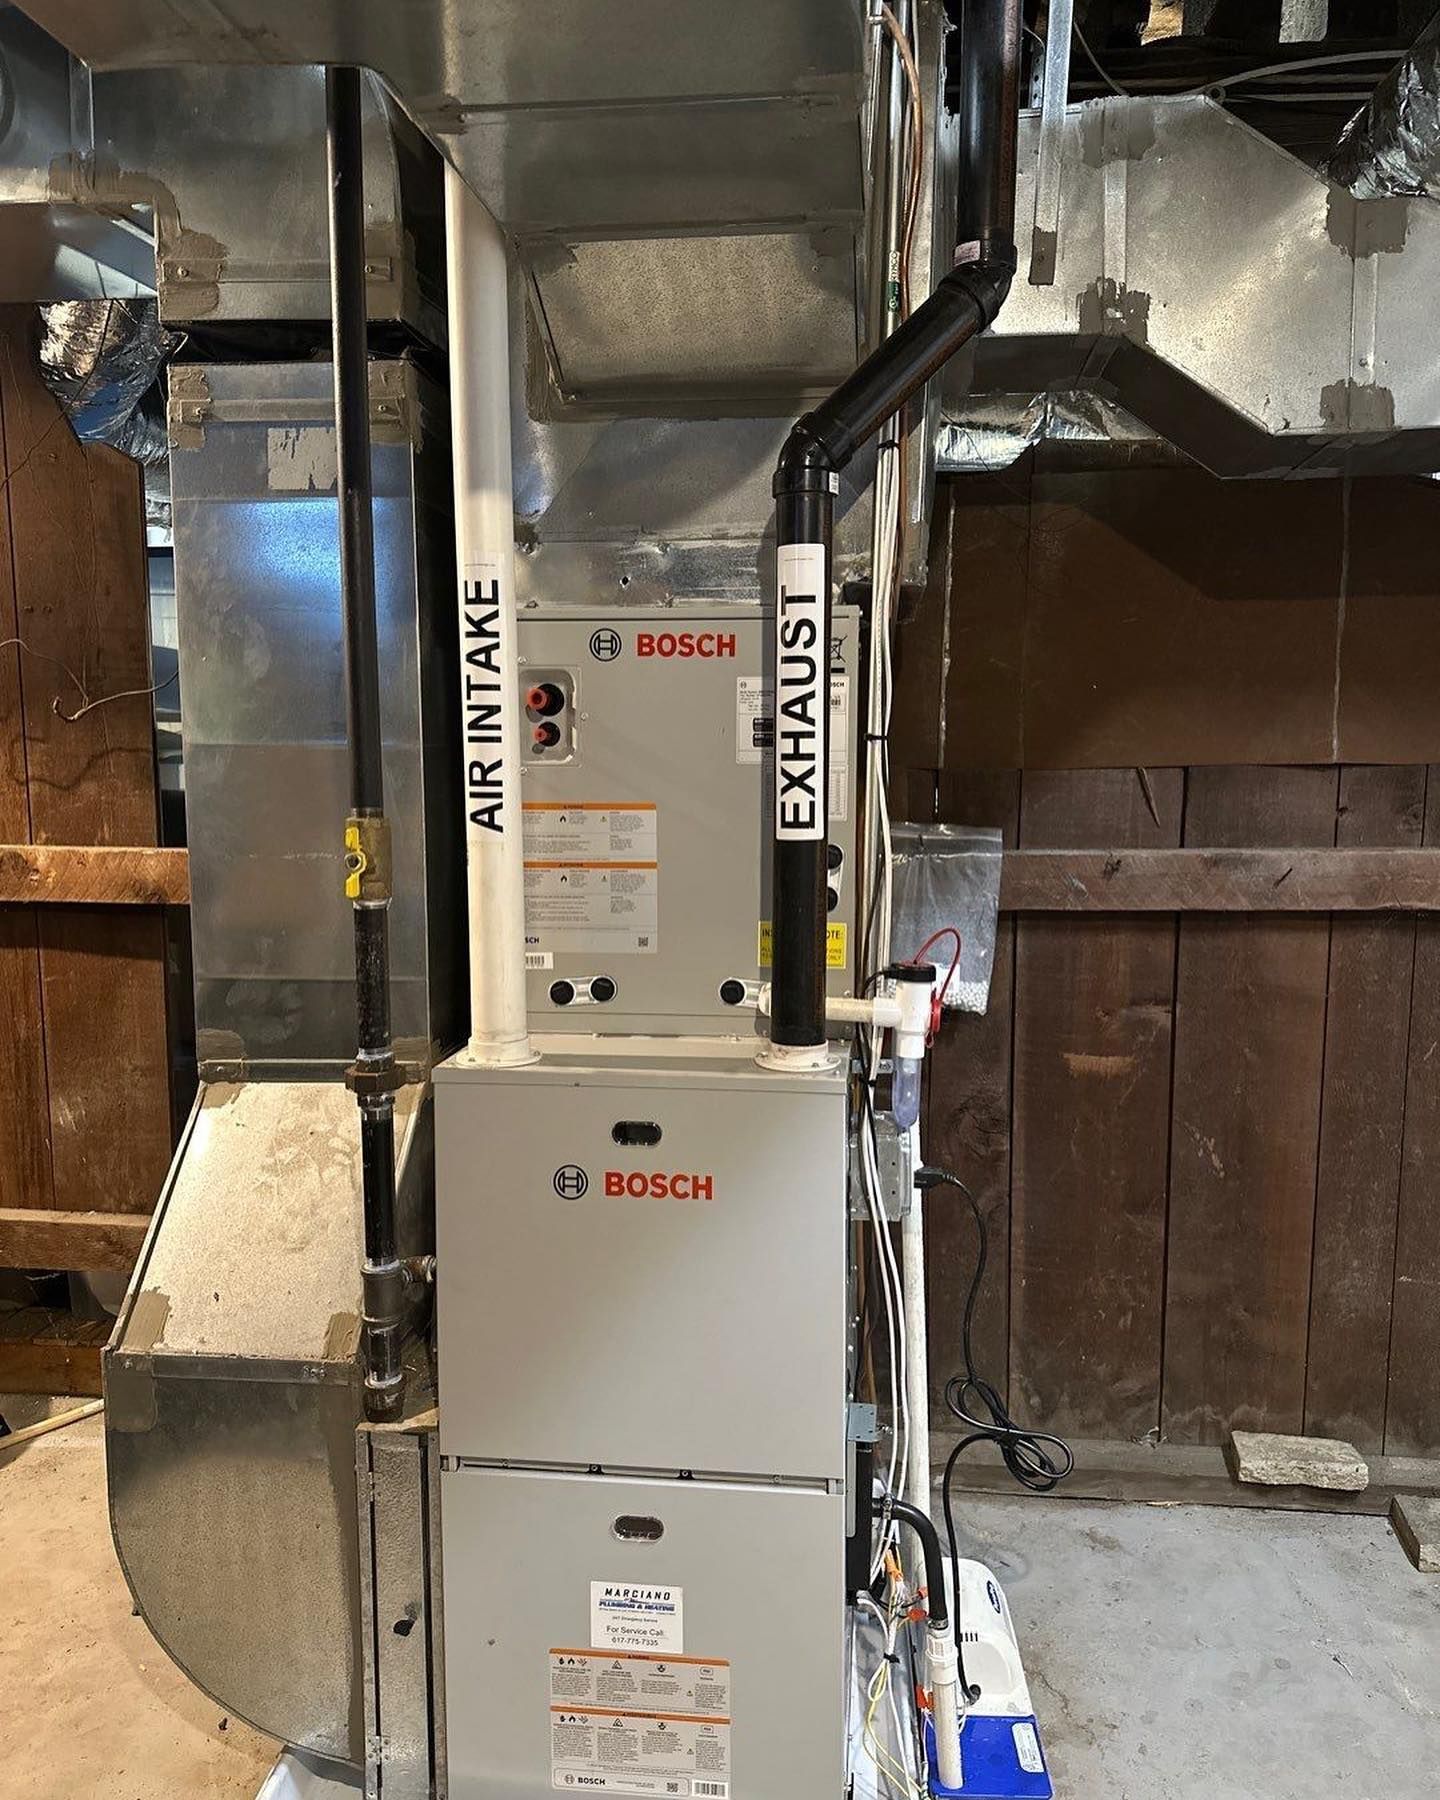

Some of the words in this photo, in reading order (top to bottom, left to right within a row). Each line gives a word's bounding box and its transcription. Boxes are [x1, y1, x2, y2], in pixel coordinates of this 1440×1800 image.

[637, 633, 736, 657] BOSCH
[464, 579, 502, 743] INTAKE
[780, 585, 817, 829] EXHAUST
[469, 759, 503, 832] AIR
[525, 936, 540, 944] SCH
[605, 1172, 713, 1201] BOSCH
[604, 1588, 671, 1601] MARCIANO
[644, 1604, 675, 1612] HEATING
[606, 1625, 620, 1633] For
[620, 1626, 648, 1635] Service
[611, 1636, 659, 1646] 617-775-7335
[577, 1777, 606, 1786] BOSCH
